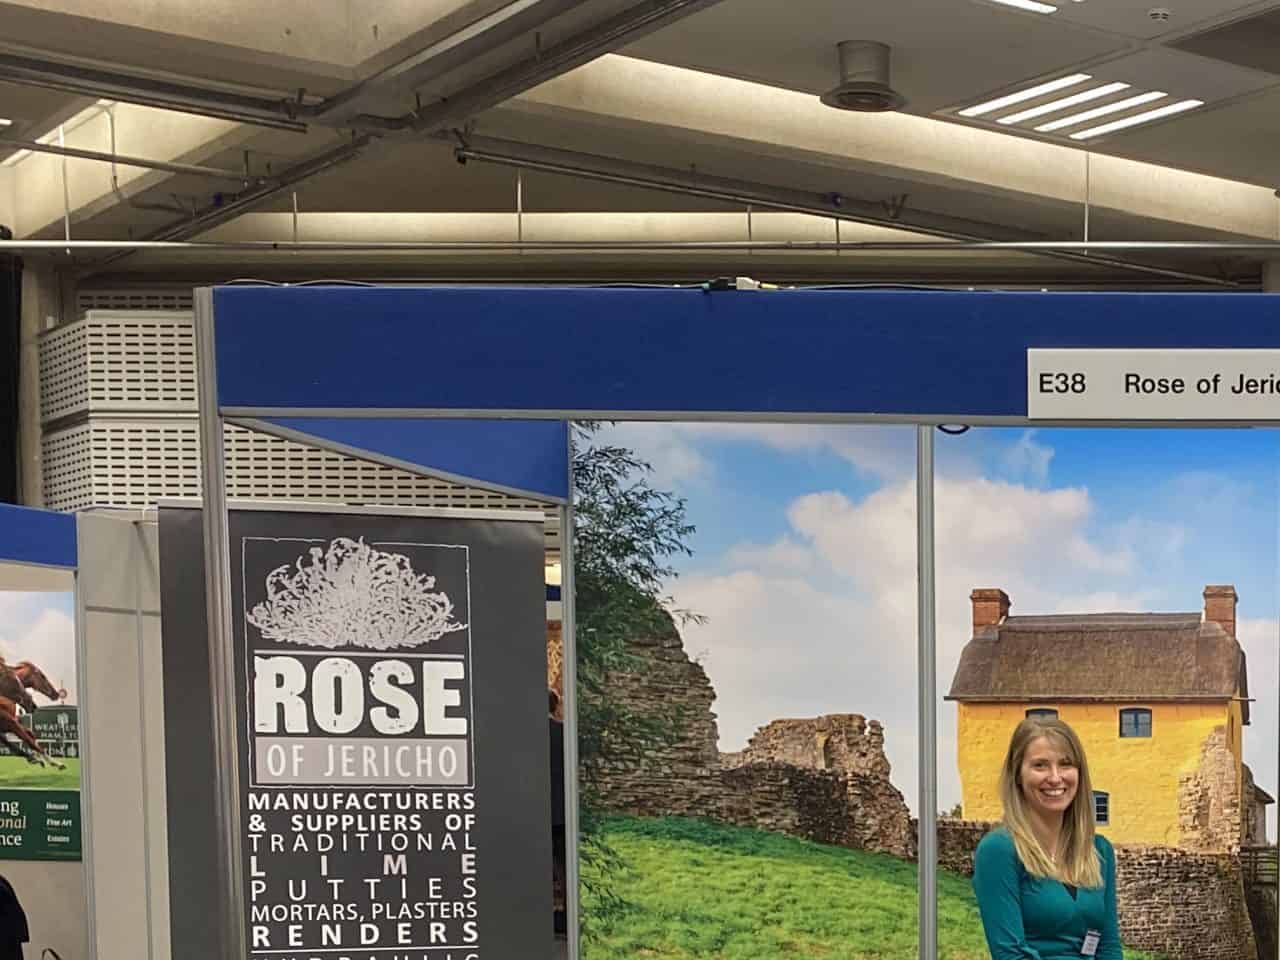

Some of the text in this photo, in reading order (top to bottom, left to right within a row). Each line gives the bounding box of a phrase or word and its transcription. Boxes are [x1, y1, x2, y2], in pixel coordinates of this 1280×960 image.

[1038, 373, 1087, 394] E38
[1124, 373, 1185, 395] Rose
[1196, 373, 1221, 395] of
[254, 656, 468, 736] ROSE
[267, 743, 458, 778] OF JERICHO
[248, 792, 475, 811] MANUFACTURERS
[249, 813, 477, 832] & SUPPLIERS OF
[248, 833, 477, 852] TRADITIONAL
[250, 853, 477, 877] LIME
[251, 877, 477, 902] PUTTIES
[251, 902, 478, 923] MORTARS, PLASTERS
[252, 921, 479, 948] RENDERS
